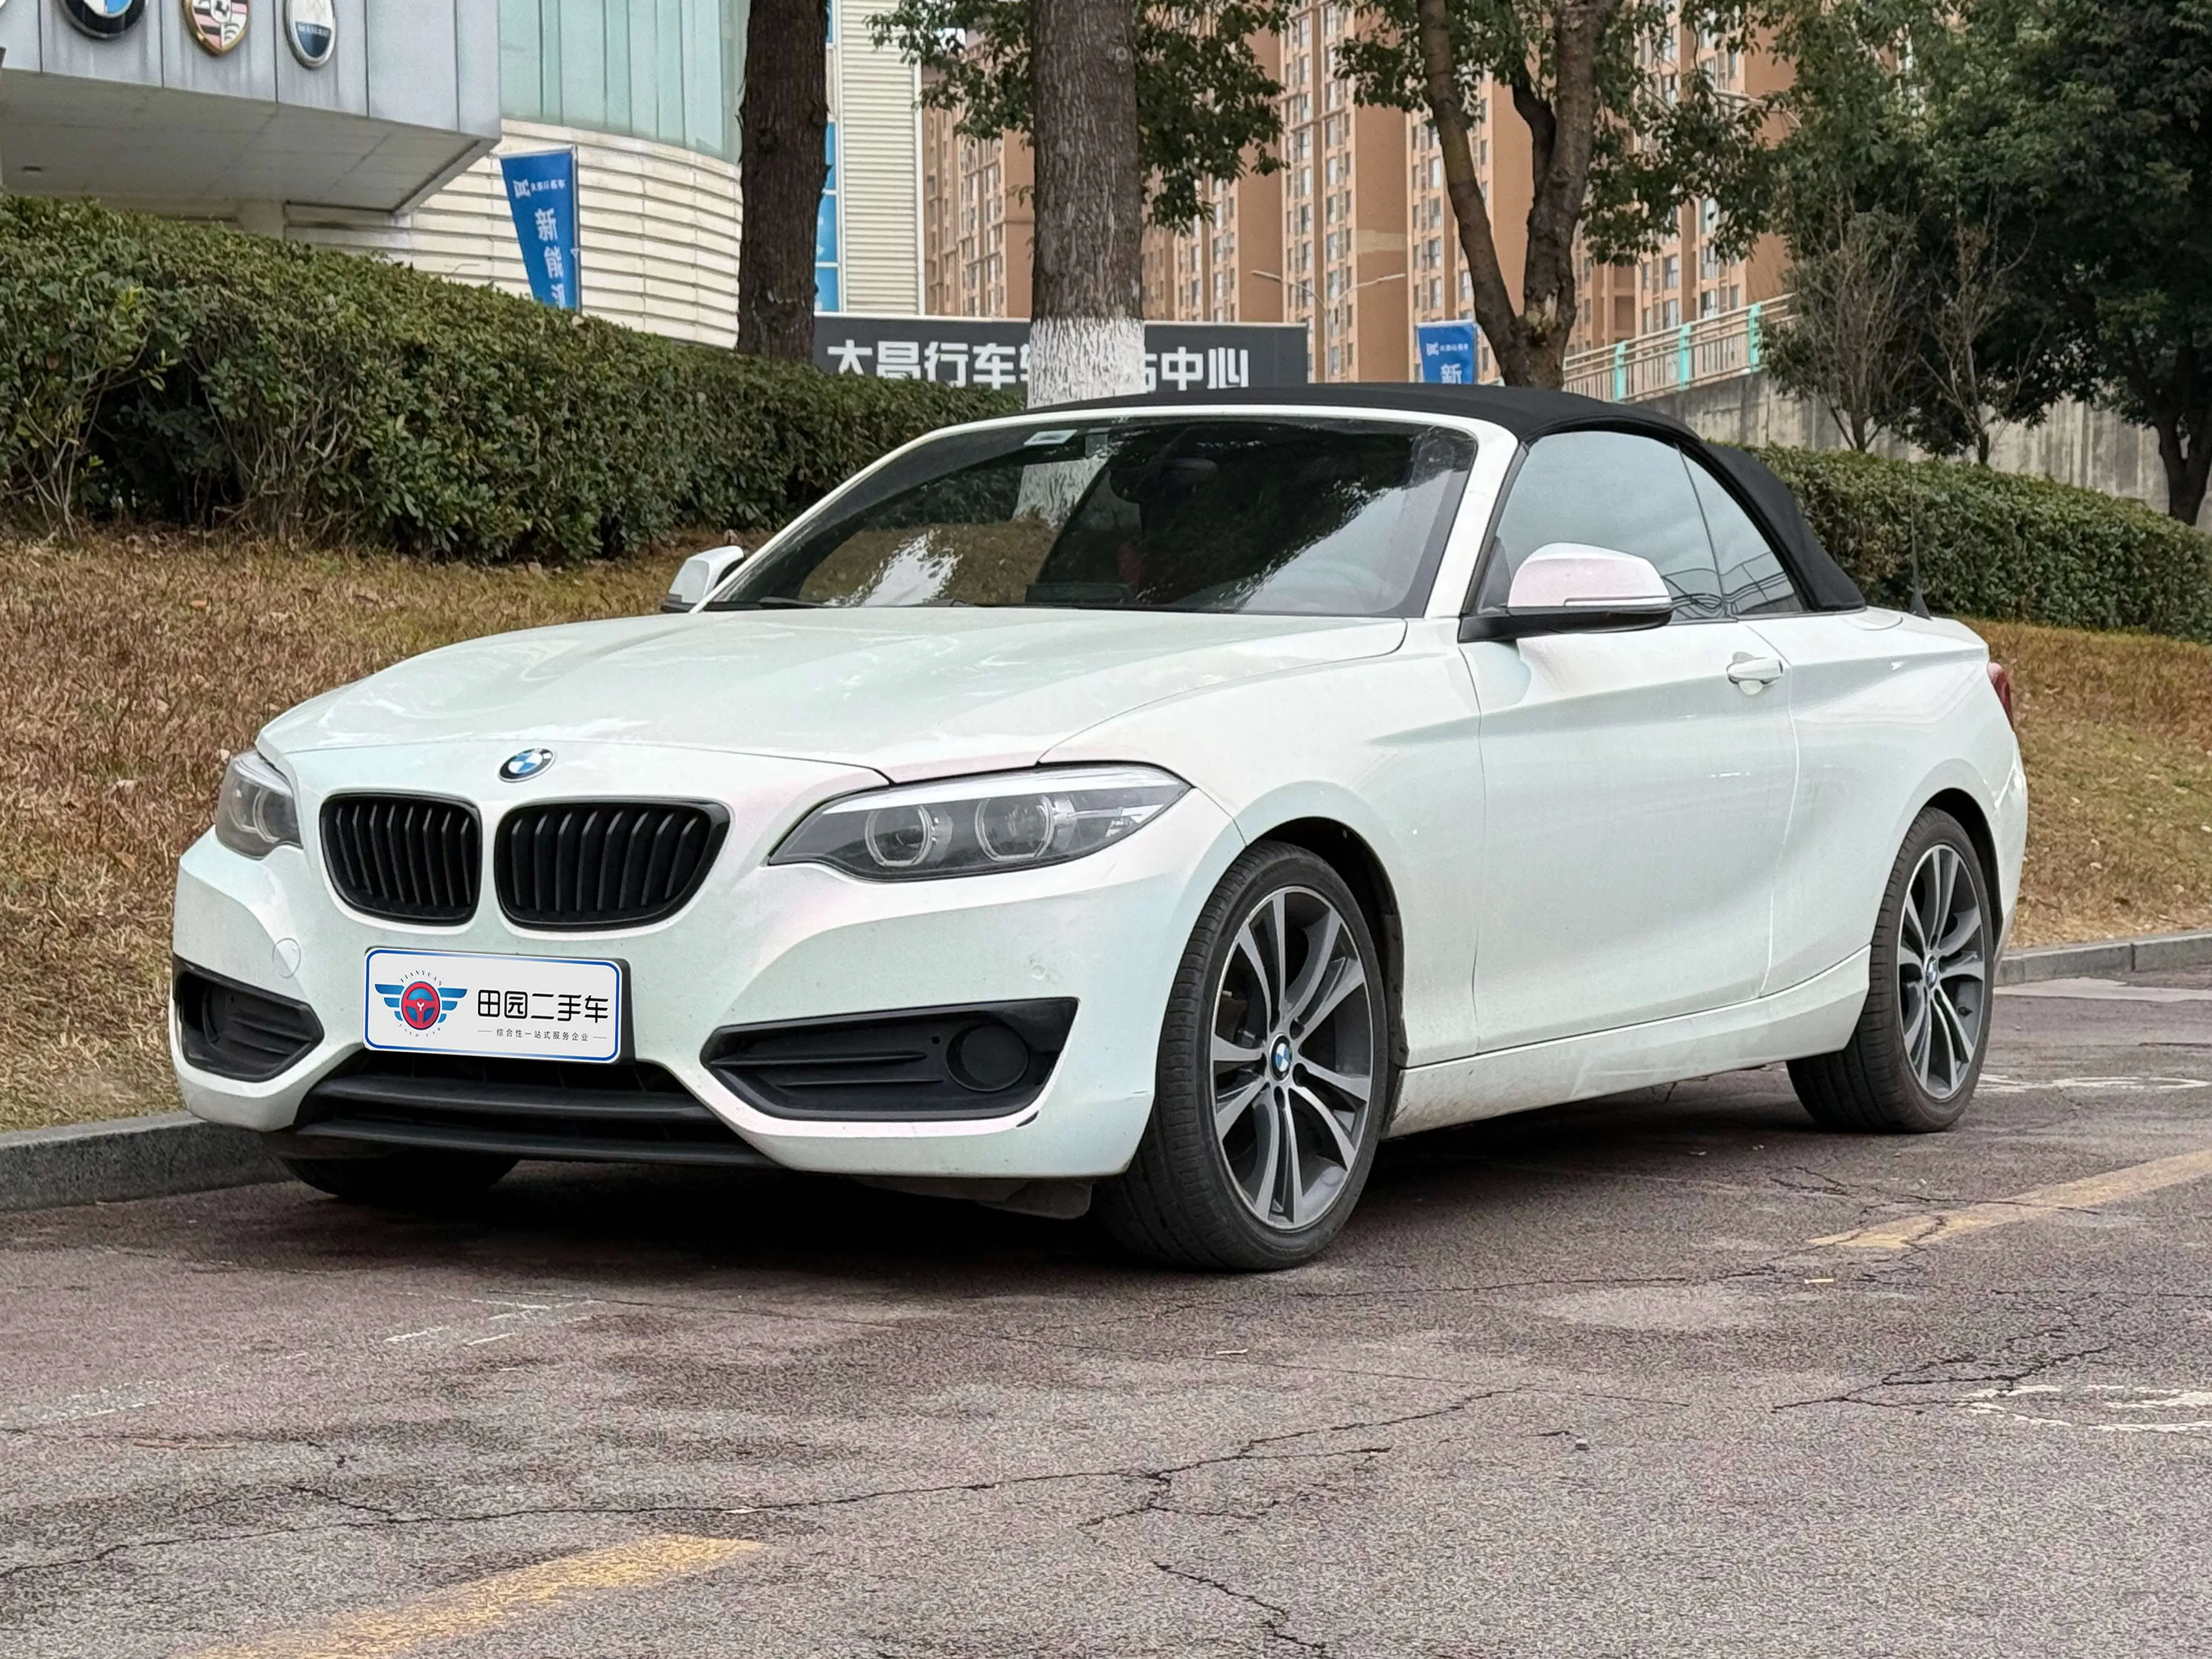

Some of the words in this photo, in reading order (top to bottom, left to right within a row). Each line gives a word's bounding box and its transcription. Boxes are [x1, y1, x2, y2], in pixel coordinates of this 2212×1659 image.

[1440, 363, 1463, 384] 新
[478, 989, 609, 1023] 田园二手车
[496, 1028, 589, 1042] 综合性一站式服务企业
